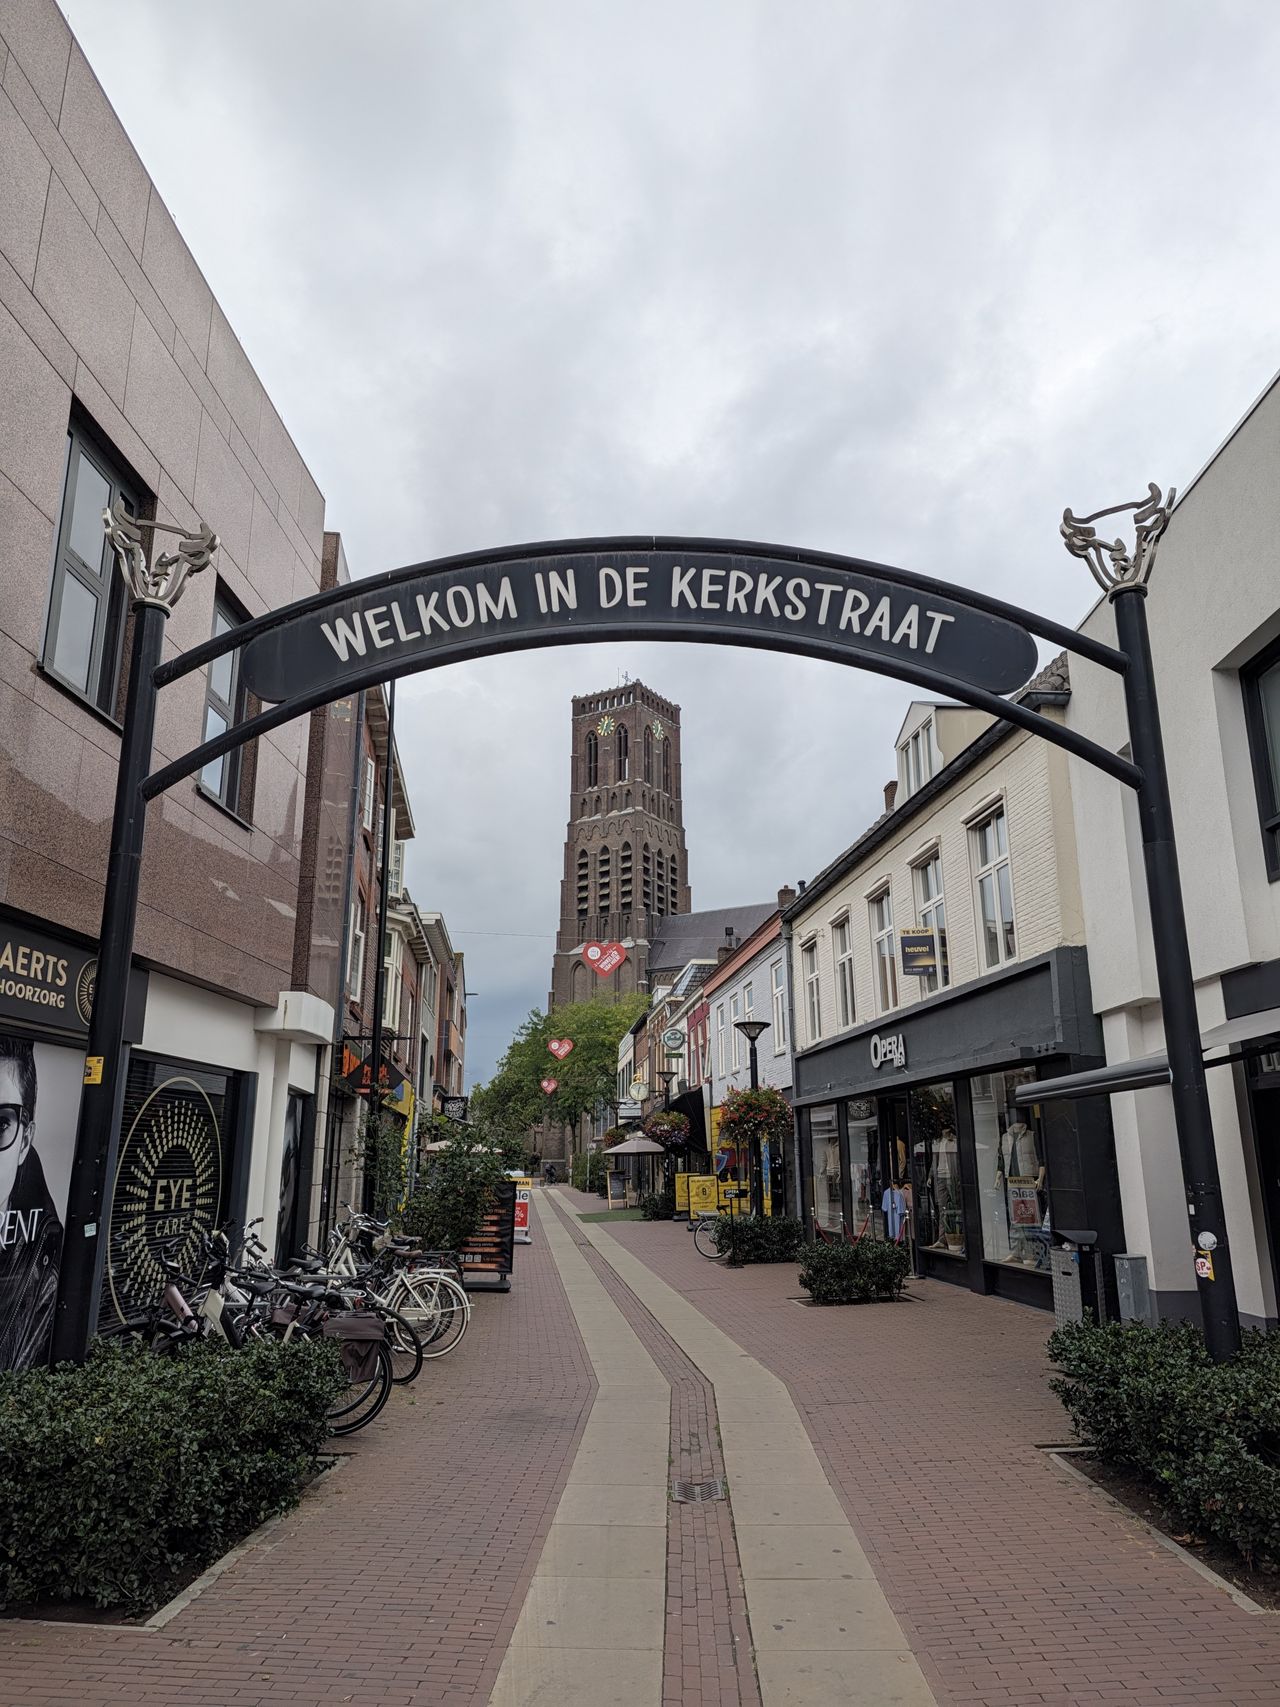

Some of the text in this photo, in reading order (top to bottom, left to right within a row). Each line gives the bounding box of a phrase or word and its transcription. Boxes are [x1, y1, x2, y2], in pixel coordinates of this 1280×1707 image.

[320, 566, 955, 662] WELKOM IN DE KERKSTRAAT
[0, 941, 68, 987] AERTS
[905, 945, 929, 953] heuvel
[871, 1034, 905, 1068] OPERA
[154, 1179, 193, 1211] EYE
[516, 1191, 528, 1200] le
